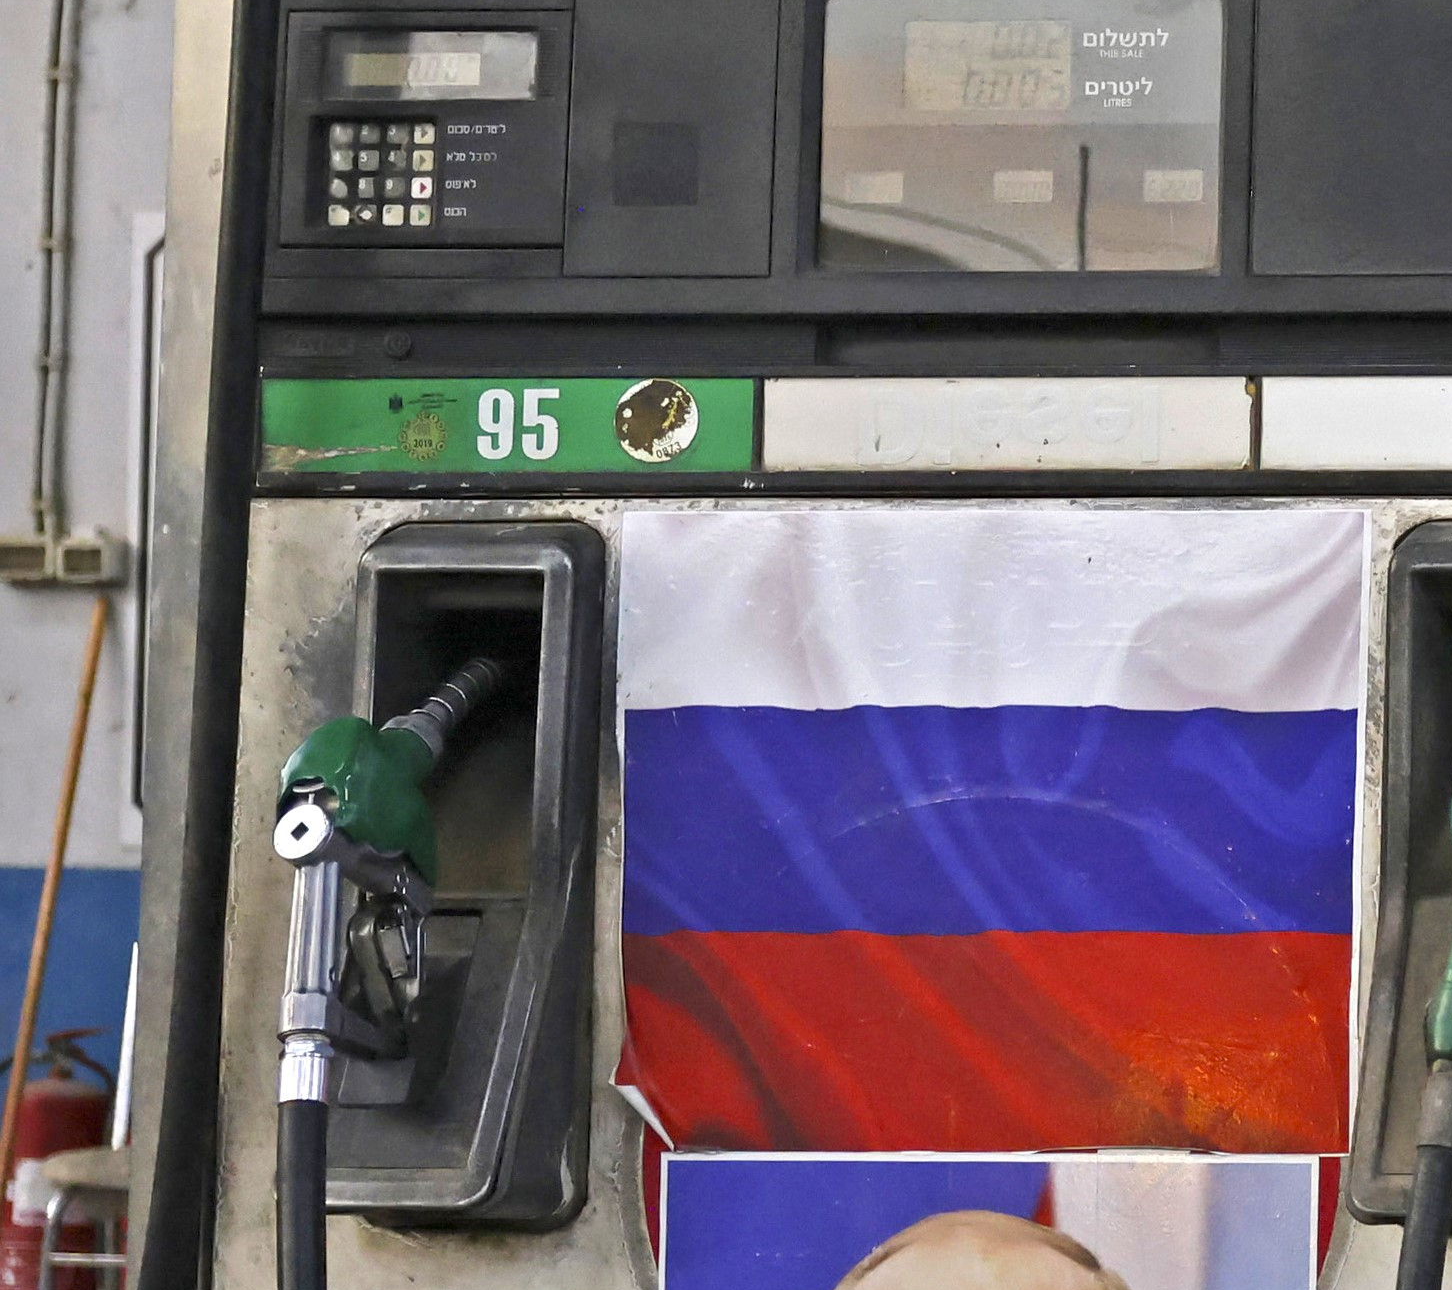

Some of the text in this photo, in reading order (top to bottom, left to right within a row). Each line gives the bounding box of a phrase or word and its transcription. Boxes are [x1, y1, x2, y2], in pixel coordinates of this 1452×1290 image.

[1082, 27, 1170, 48] לתשלום
[1084, 76, 1153, 97] ליטרים
[1103, 98, 1132, 108] LITRES
[475, 387, 561, 460] 95
